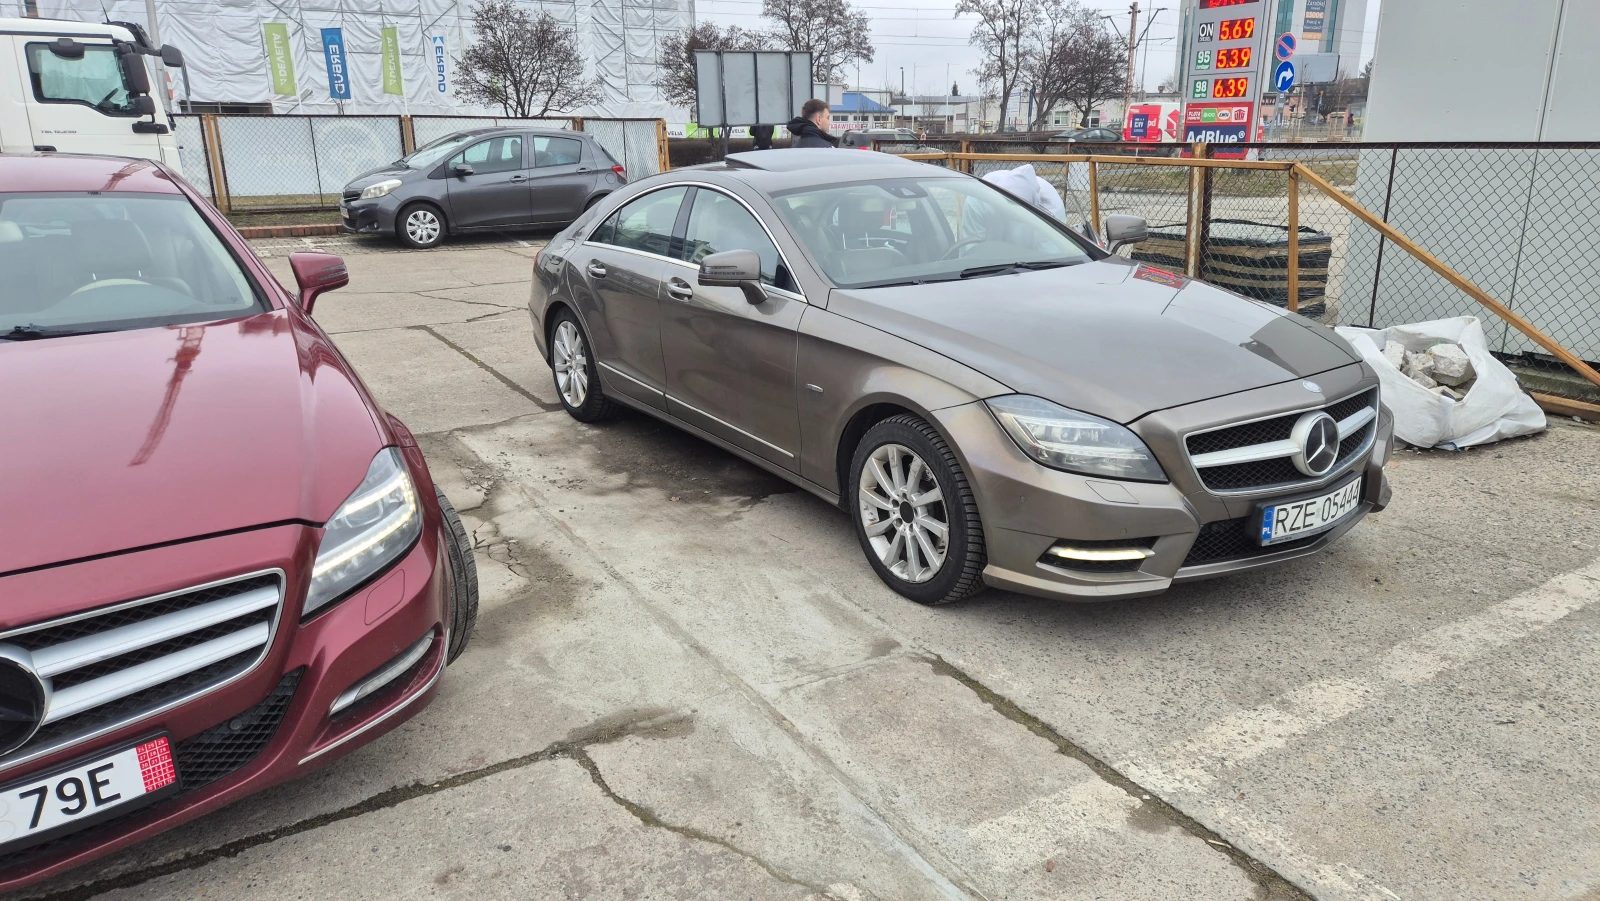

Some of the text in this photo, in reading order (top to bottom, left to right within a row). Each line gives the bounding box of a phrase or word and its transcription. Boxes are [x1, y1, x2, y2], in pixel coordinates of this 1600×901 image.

[1199, 18, 1255, 40] ON 5.69
[1197, 47, 1252, 68] 95 5.39
[1195, 78, 1247, 98] 98 6.39
[1274, 480, 1361, 535] RZE 05444
[1262, 527, 1271, 535] PL
[18, 761, 122, 830] 79E
